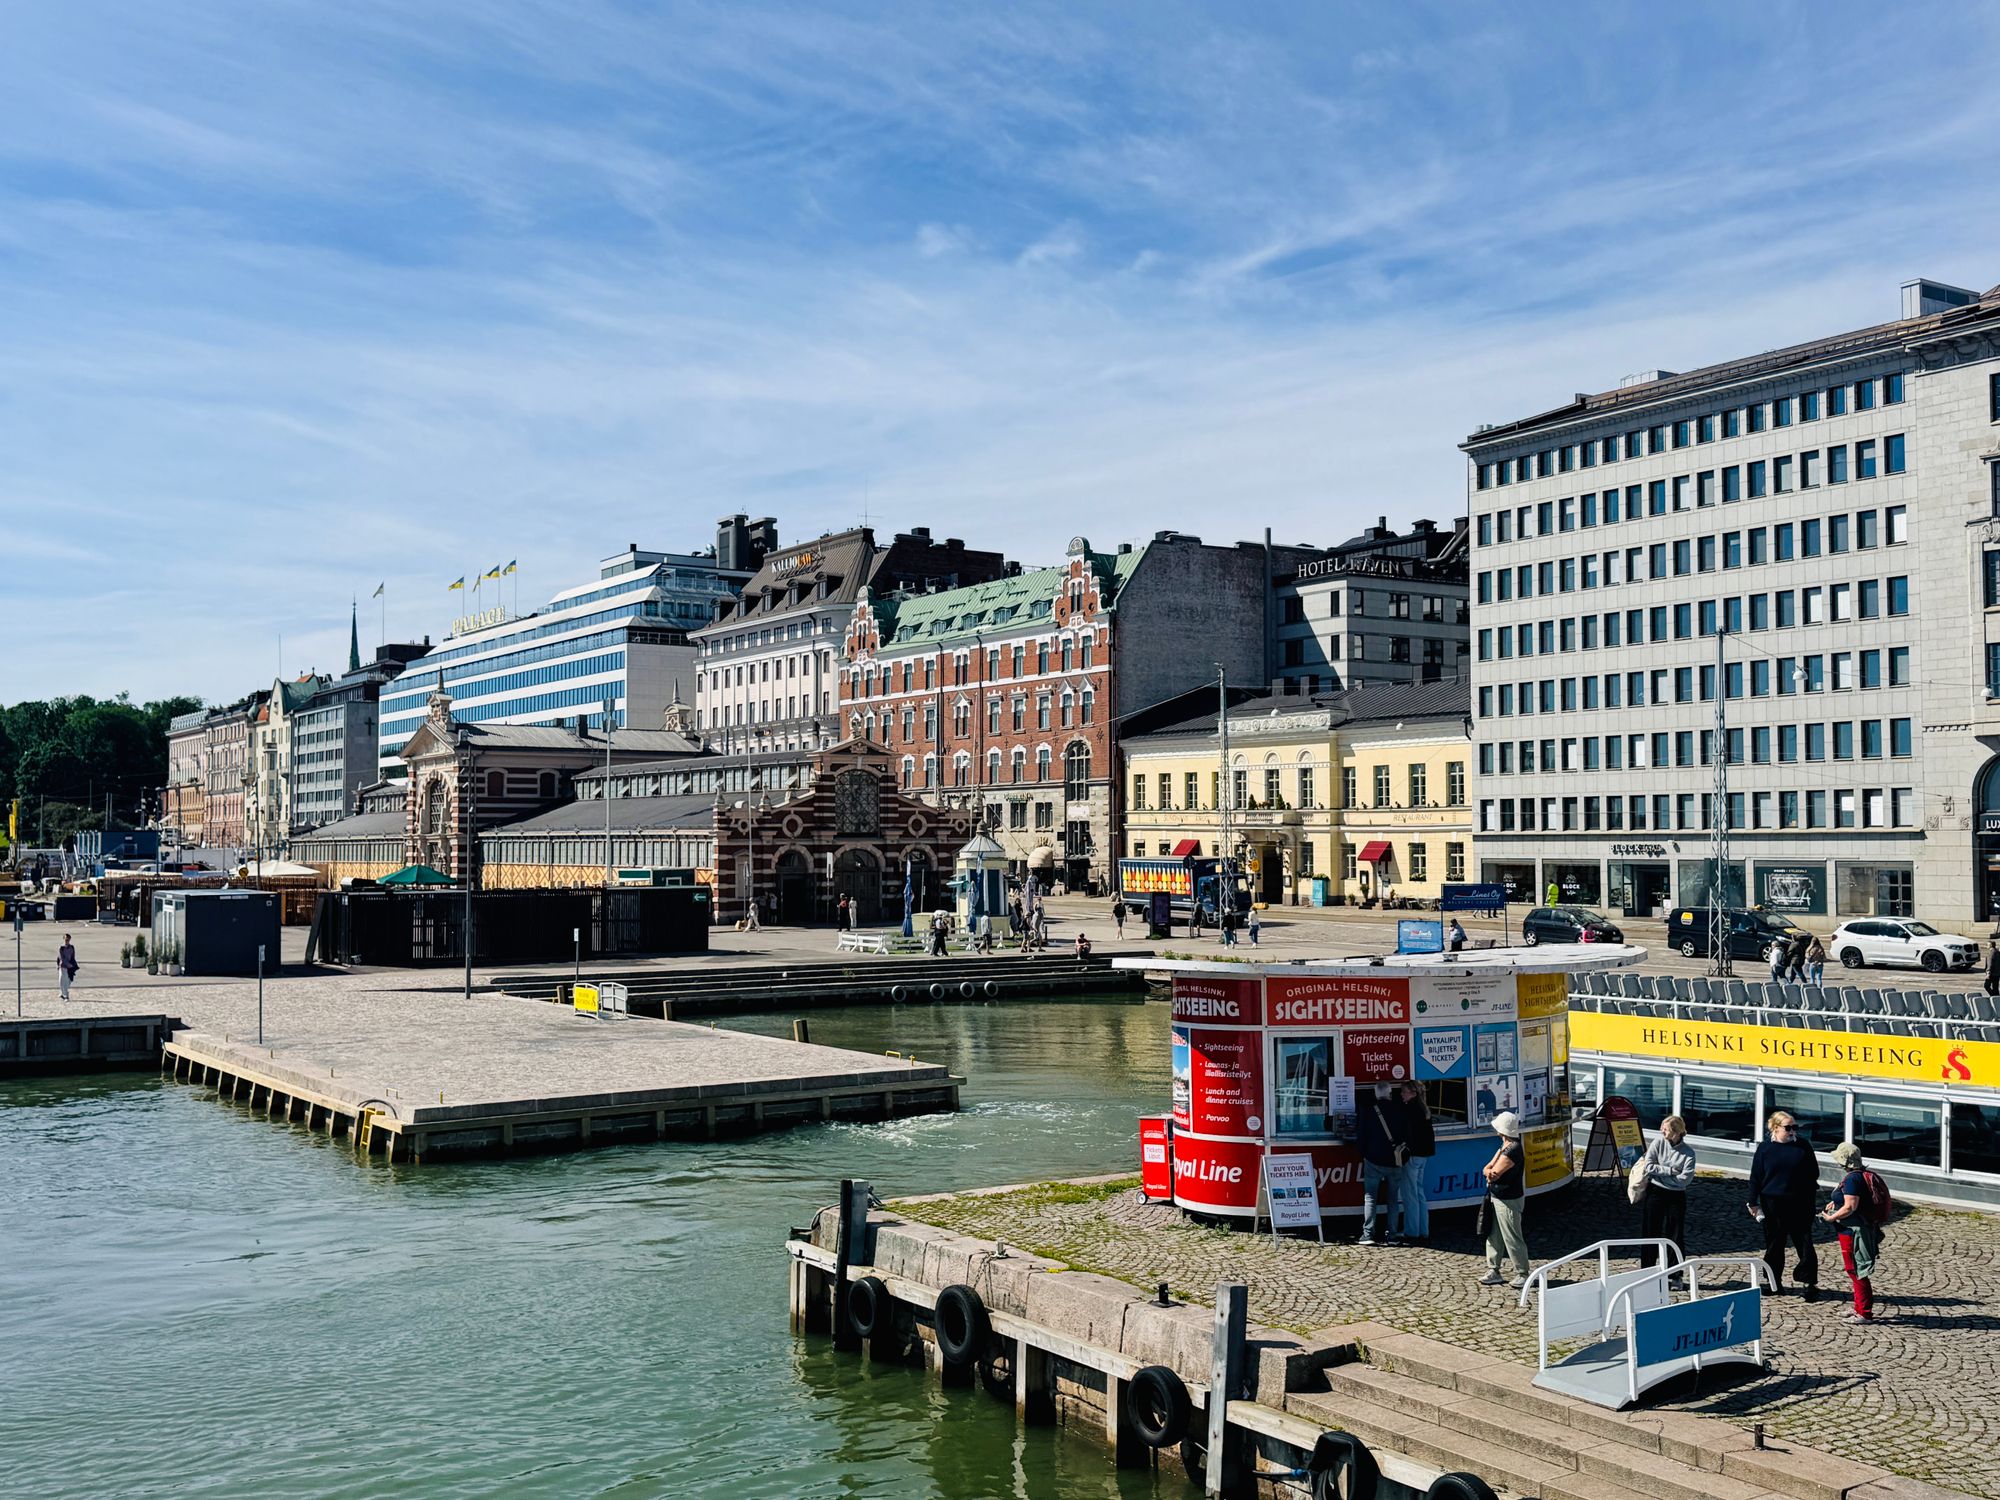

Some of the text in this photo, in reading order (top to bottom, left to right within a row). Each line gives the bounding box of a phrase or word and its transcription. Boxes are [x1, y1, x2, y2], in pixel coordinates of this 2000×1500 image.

[1297, 558, 1340, 577] HOTEL
[1471, 889, 1490, 898] Lines
[1190, 986, 1226, 998] HELSINKI
[1286, 983, 1391, 998] ORIGINAL HELSINKI
[1275, 998, 1403, 1020] SIGHTSEEING
[1347, 1033, 1405, 1047] Sightseeing
[1423, 1036, 1461, 1045] MATKALIPUT
[1204, 1043, 1244, 1053] Sightseeing
[1428, 1045, 1458, 1054] BILJETTER
[1642, 1028, 1923, 1067] HELSINKI SIGHTSEEING
[1361, 1052, 1393, 1062] Tickets
[1431, 1054, 1455, 1062] TICKETS
[1232, 1062, 1240, 1070] ja
[1366, 1062, 1389, 1074] Liput
[1205, 1088, 1240, 1096] Lunch and
[1205, 1096, 1254, 1106] dinner cruises
[1205, 1114, 1230, 1123] Porvoo
[1174, 1157, 1243, 1183] oyal Line
[1433, 1172, 1484, 1193] JT-LI
[1281, 1210, 1310, 1219] Royal Line
[1672, 1325, 1726, 1352] JT-LINE
